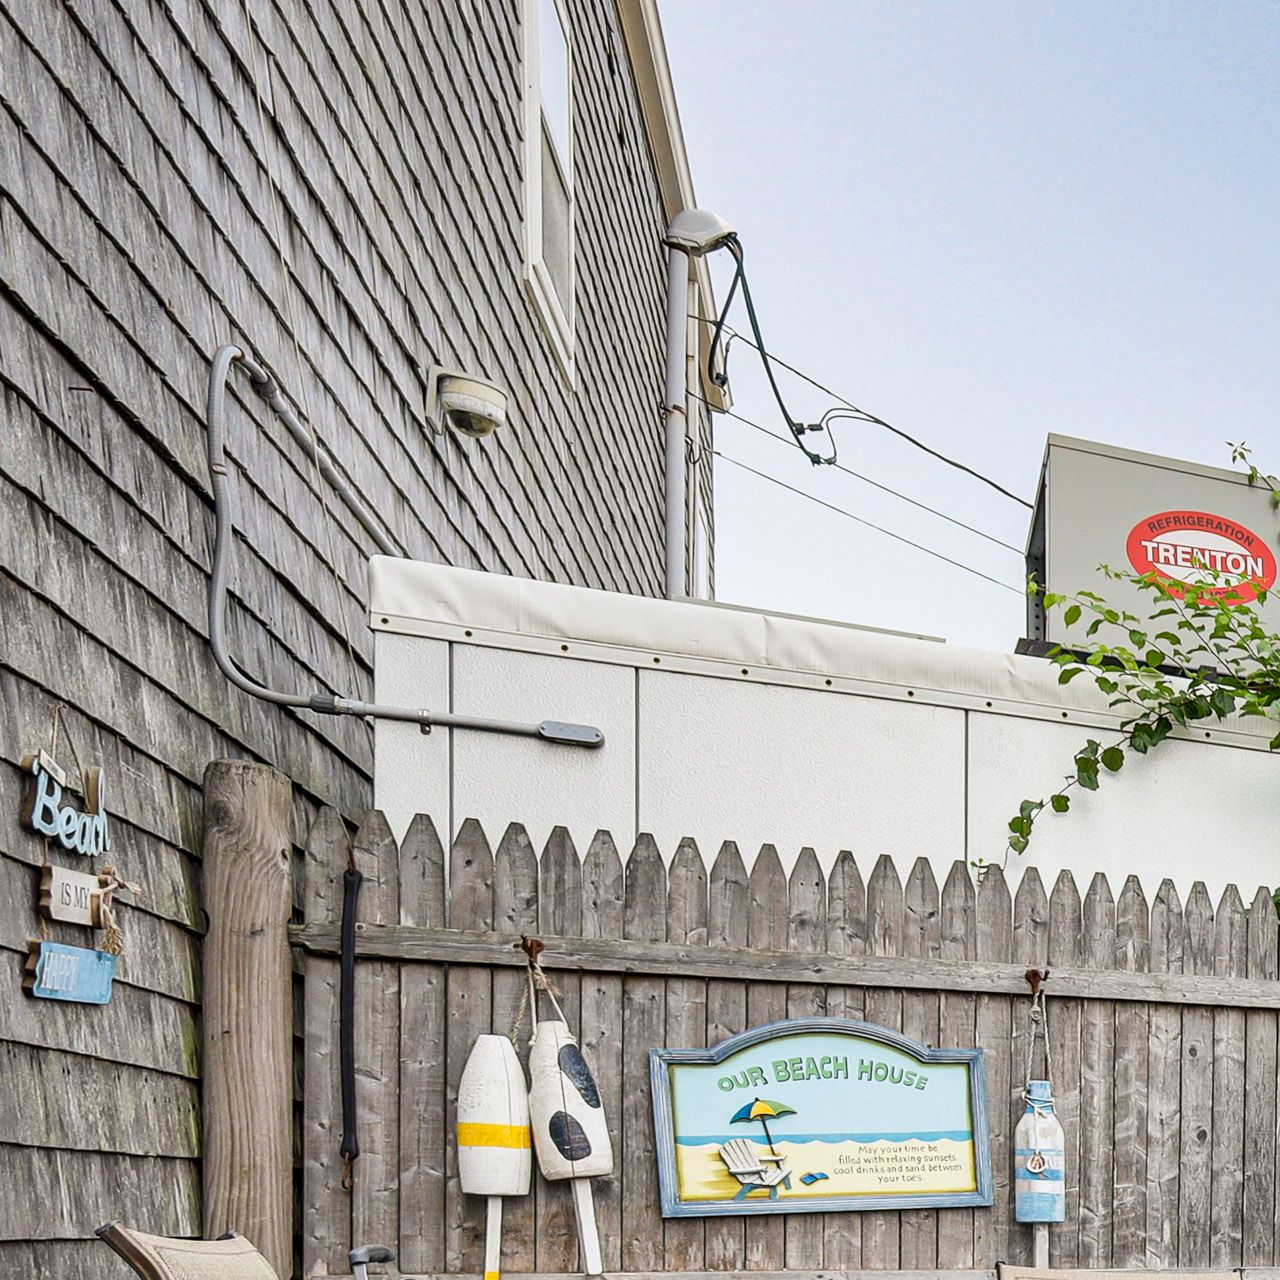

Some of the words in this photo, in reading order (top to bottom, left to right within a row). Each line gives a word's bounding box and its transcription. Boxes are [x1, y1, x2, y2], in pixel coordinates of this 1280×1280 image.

[1147, 515, 1254, 547] REFRIGERATION
[1140, 539, 1265, 578] TRENTON
[31, 757, 111, 857] Beach
[61, 882, 71, 906] IS
[74, 885, 90, 910] MY
[717, 1066, 768, 1092] OUR
[772, 1055, 849, 1082] BEACH
[857, 1058, 929, 1091] HOUSE
[838, 1154, 861, 1164] filled
[864, 1154, 885, 1163] with
[886, 1154, 921, 1164] relaxing
[858, 1145, 878, 1155] May
[880, 1146, 902, 1155] your
[904, 1145, 925, 1153] time
[928, 1144, 938, 1152] be
[833, 1165, 854, 1175] cool
[856, 1165, 885, 1174] drinks
[886, 1164, 903, 1173] and
[905, 1164, 925, 1173] sand
[928, 1163, 962, 1172] between
[877, 1174, 900, 1184] your
